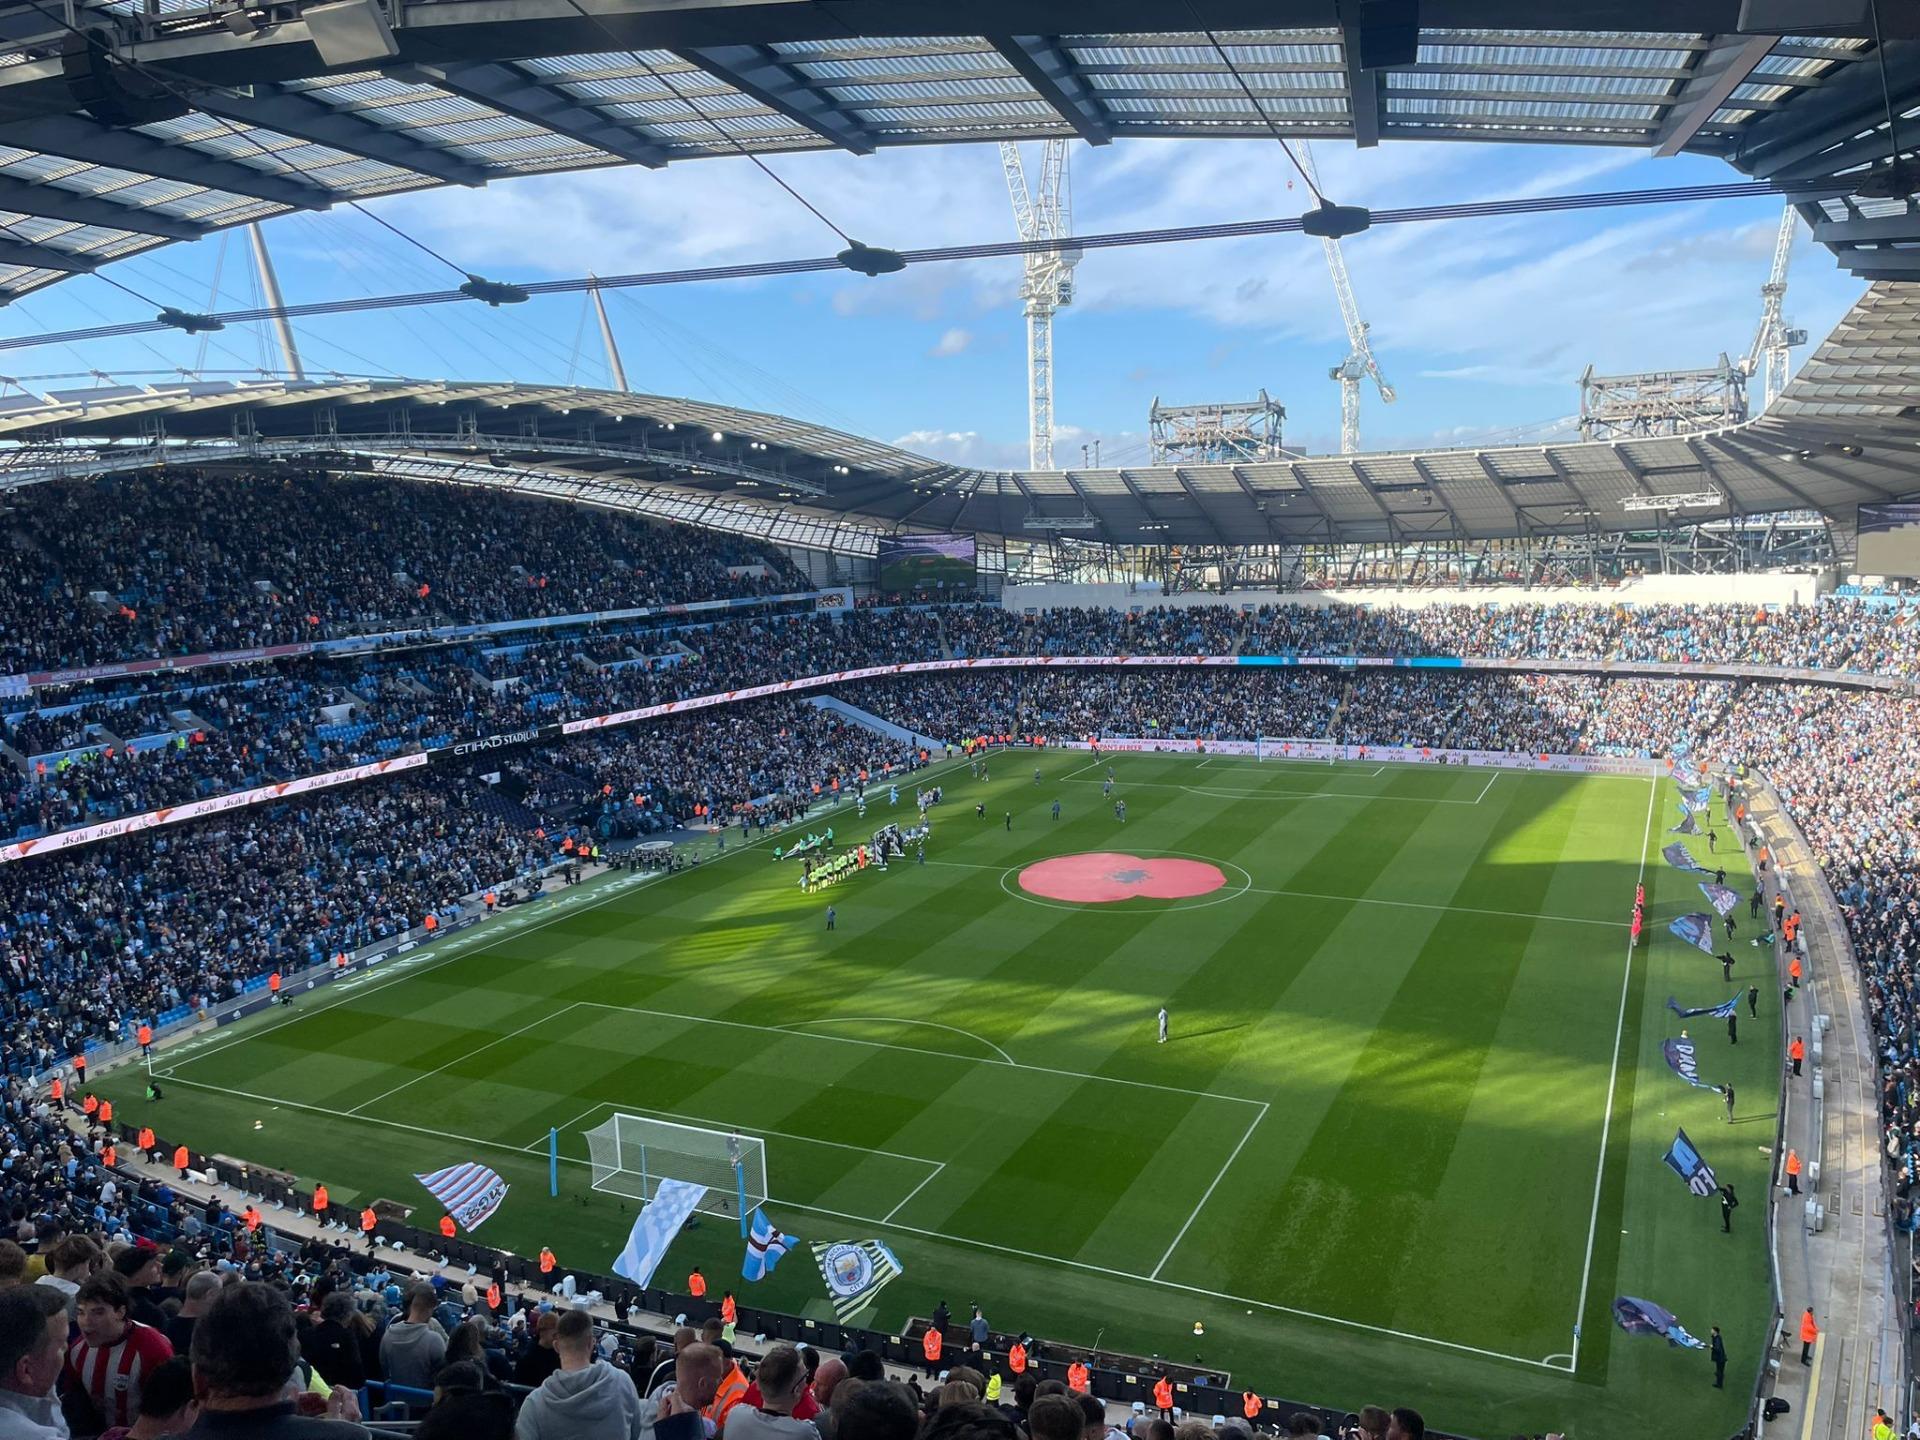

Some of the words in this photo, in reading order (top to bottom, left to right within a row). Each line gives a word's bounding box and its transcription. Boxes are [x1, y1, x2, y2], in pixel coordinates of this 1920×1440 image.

[454, 738, 503, 756] ETIHAD
[504, 730, 539, 746] STADIUM
[97, 823, 122, 837] Asahi
[62, 831, 89, 846] Asahi
[826, 1244, 865, 1269] MANCHESTER
[849, 1280, 865, 1293] CITY
